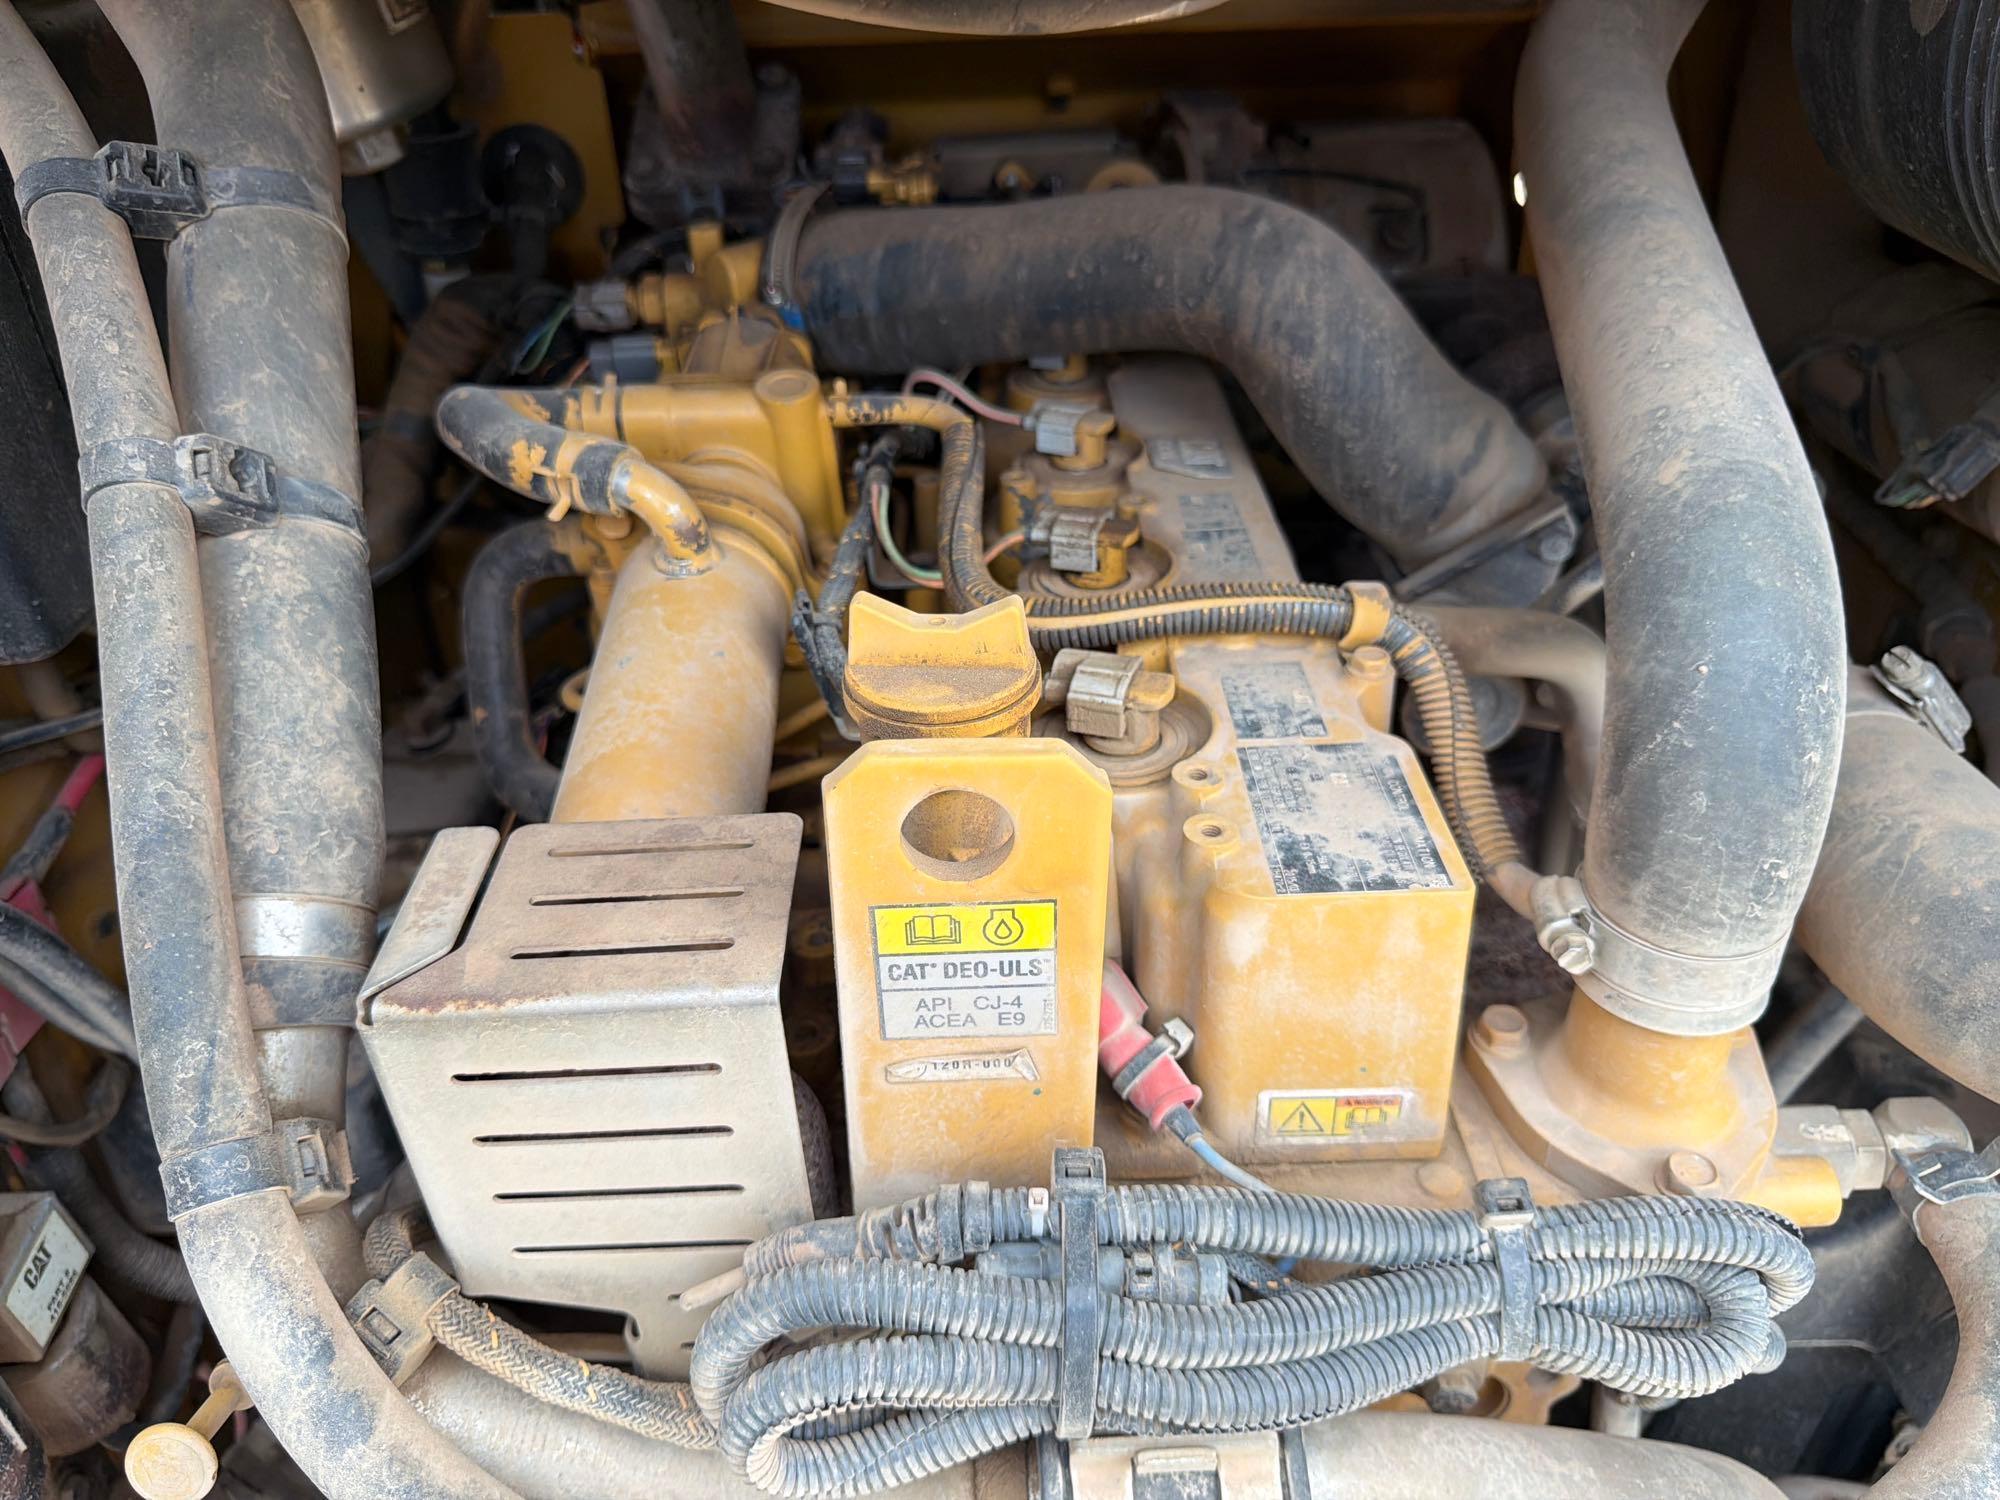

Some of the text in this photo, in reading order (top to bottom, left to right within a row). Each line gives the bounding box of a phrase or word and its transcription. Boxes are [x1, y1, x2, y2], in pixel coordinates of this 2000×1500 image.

[915, 995, 1023, 1012] API CJ-4
[914, 1012, 1025, 1029] ACEA E9
[24, 1238, 52, 1291] CAT
